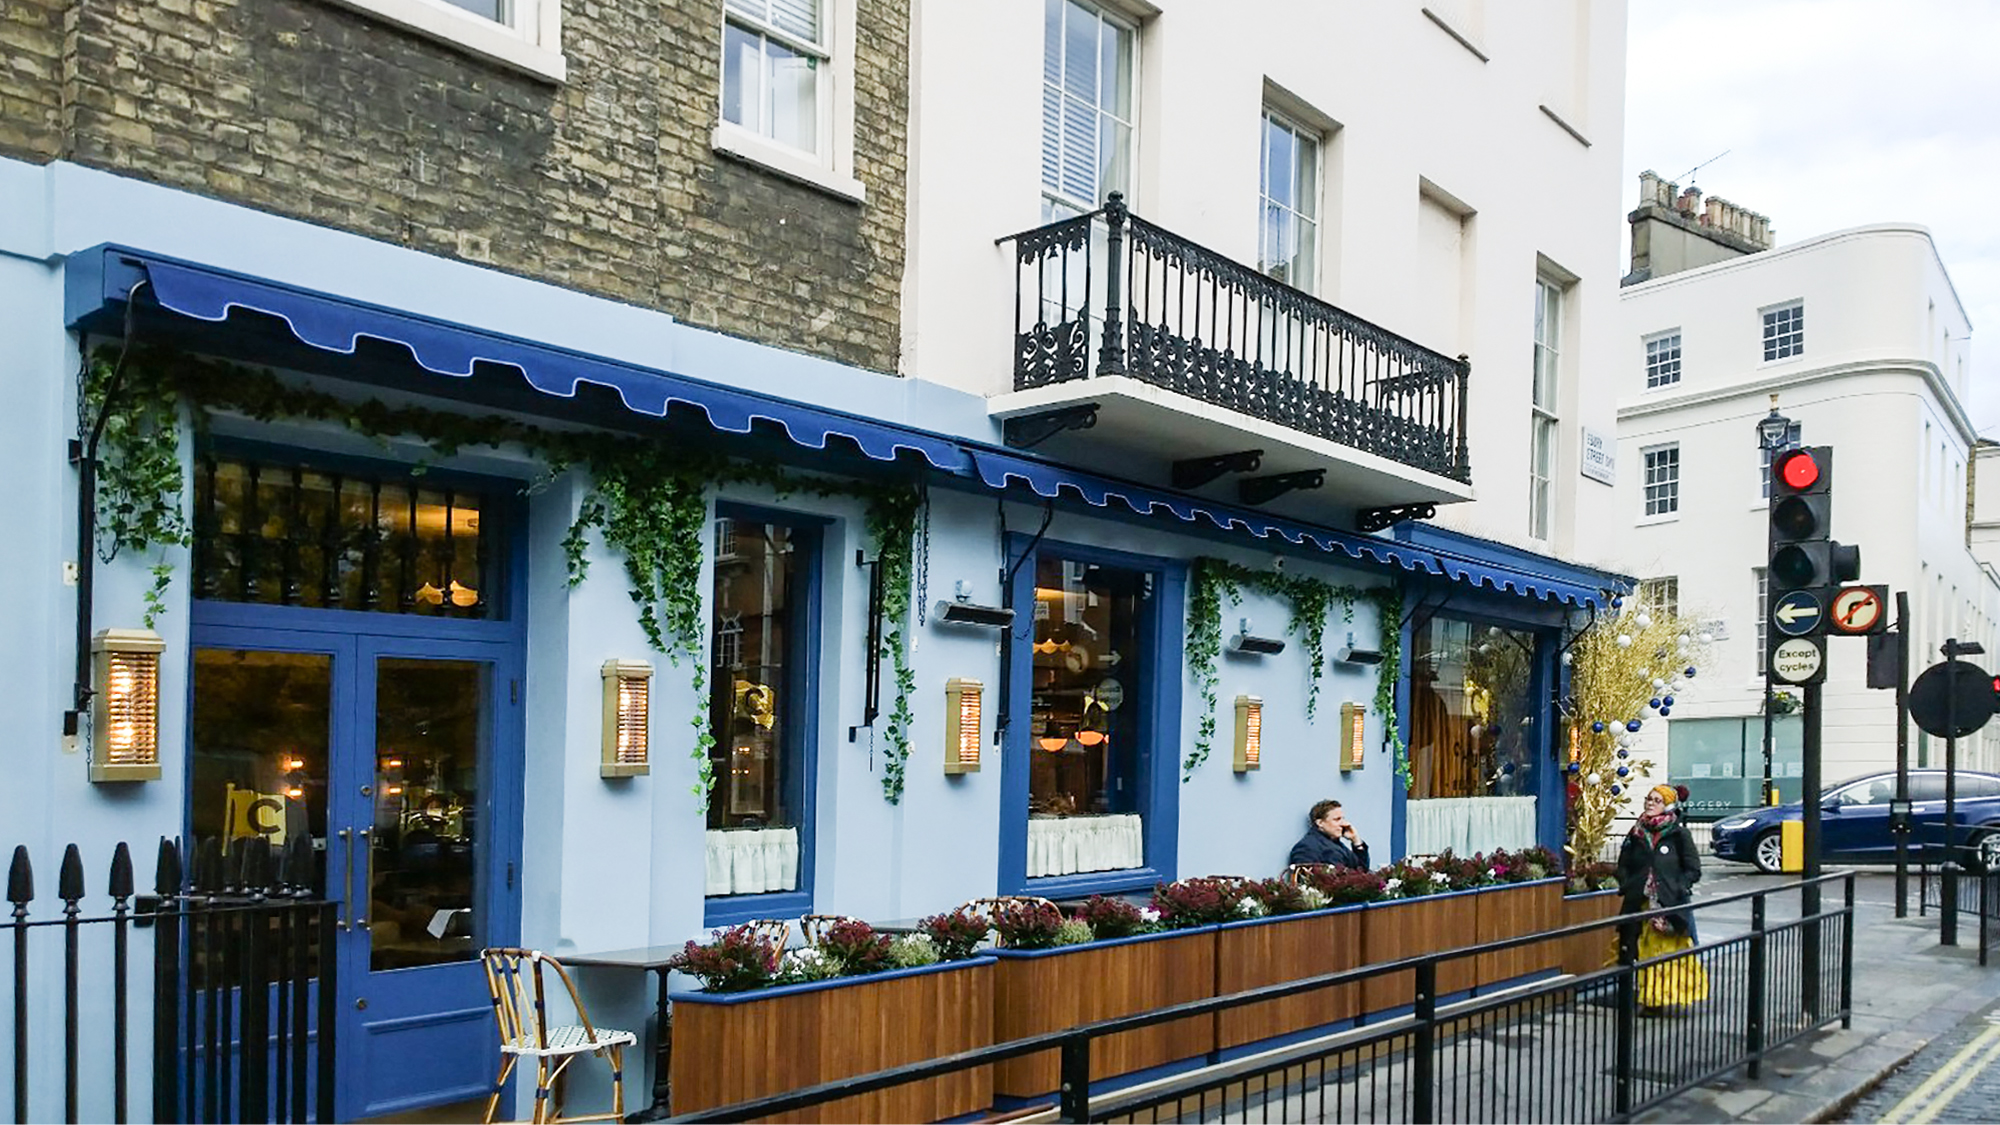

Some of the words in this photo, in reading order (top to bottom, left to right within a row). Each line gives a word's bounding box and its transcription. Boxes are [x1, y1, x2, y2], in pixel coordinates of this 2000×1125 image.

[1779, 649, 1816, 659] Except
[1780, 662, 1814, 673] cycles
[247, 798, 283, 834] C
